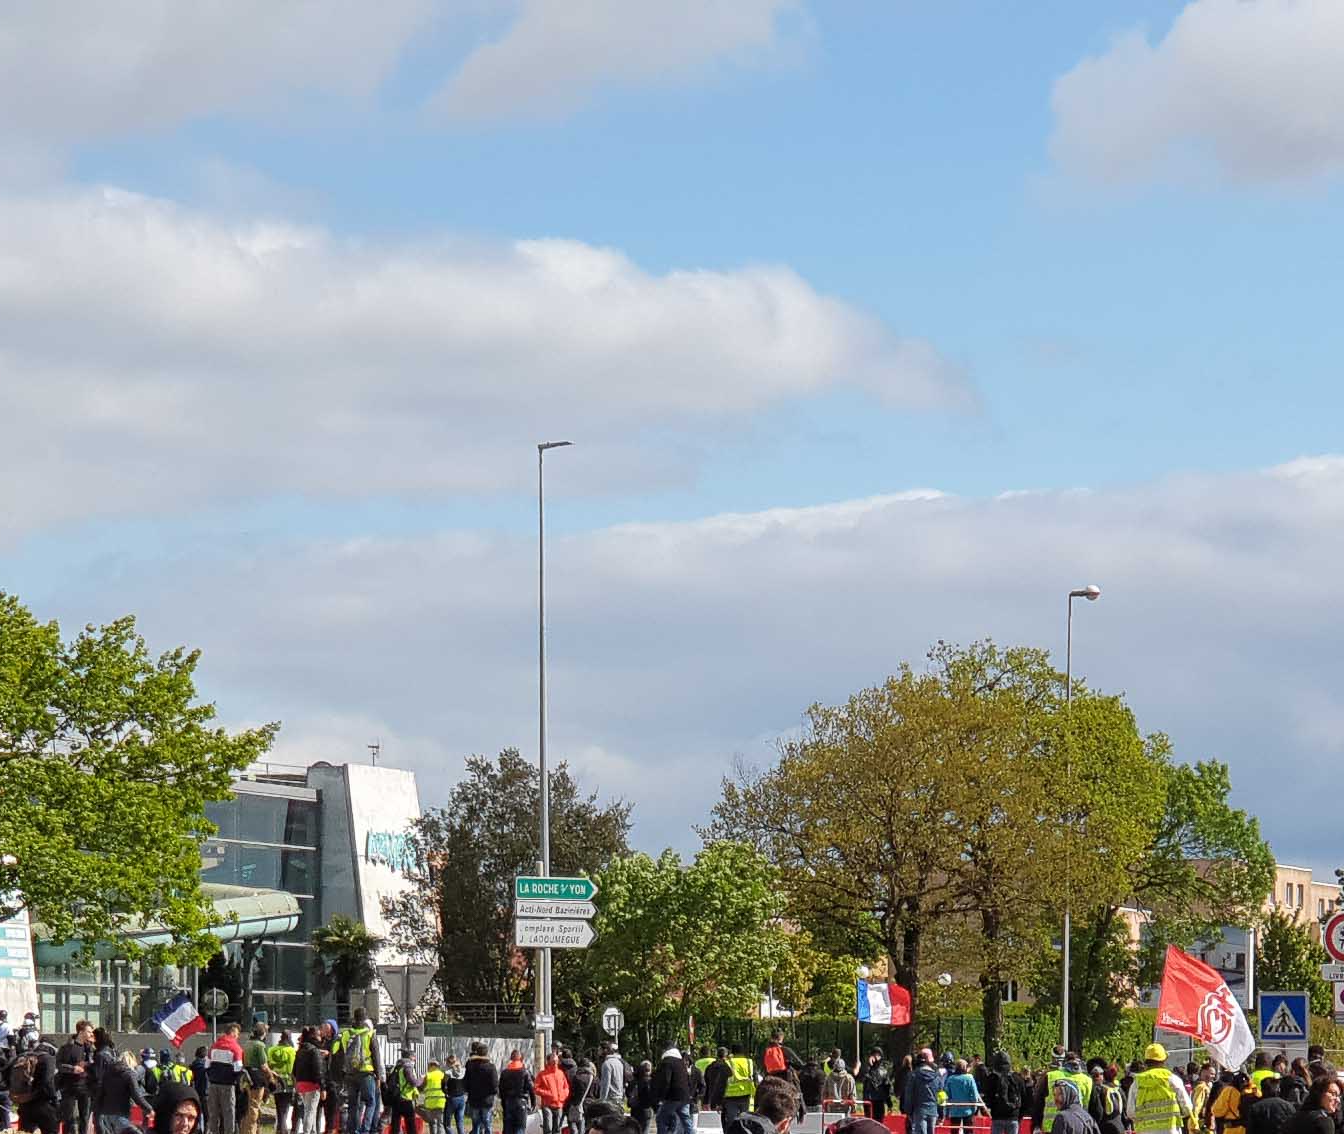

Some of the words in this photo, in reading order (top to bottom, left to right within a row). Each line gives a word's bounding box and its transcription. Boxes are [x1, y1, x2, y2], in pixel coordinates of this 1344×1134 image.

[519, 883, 530, 894] LA
[532, 883, 559, 894] ROCHE
[569, 884, 586, 896] YON
